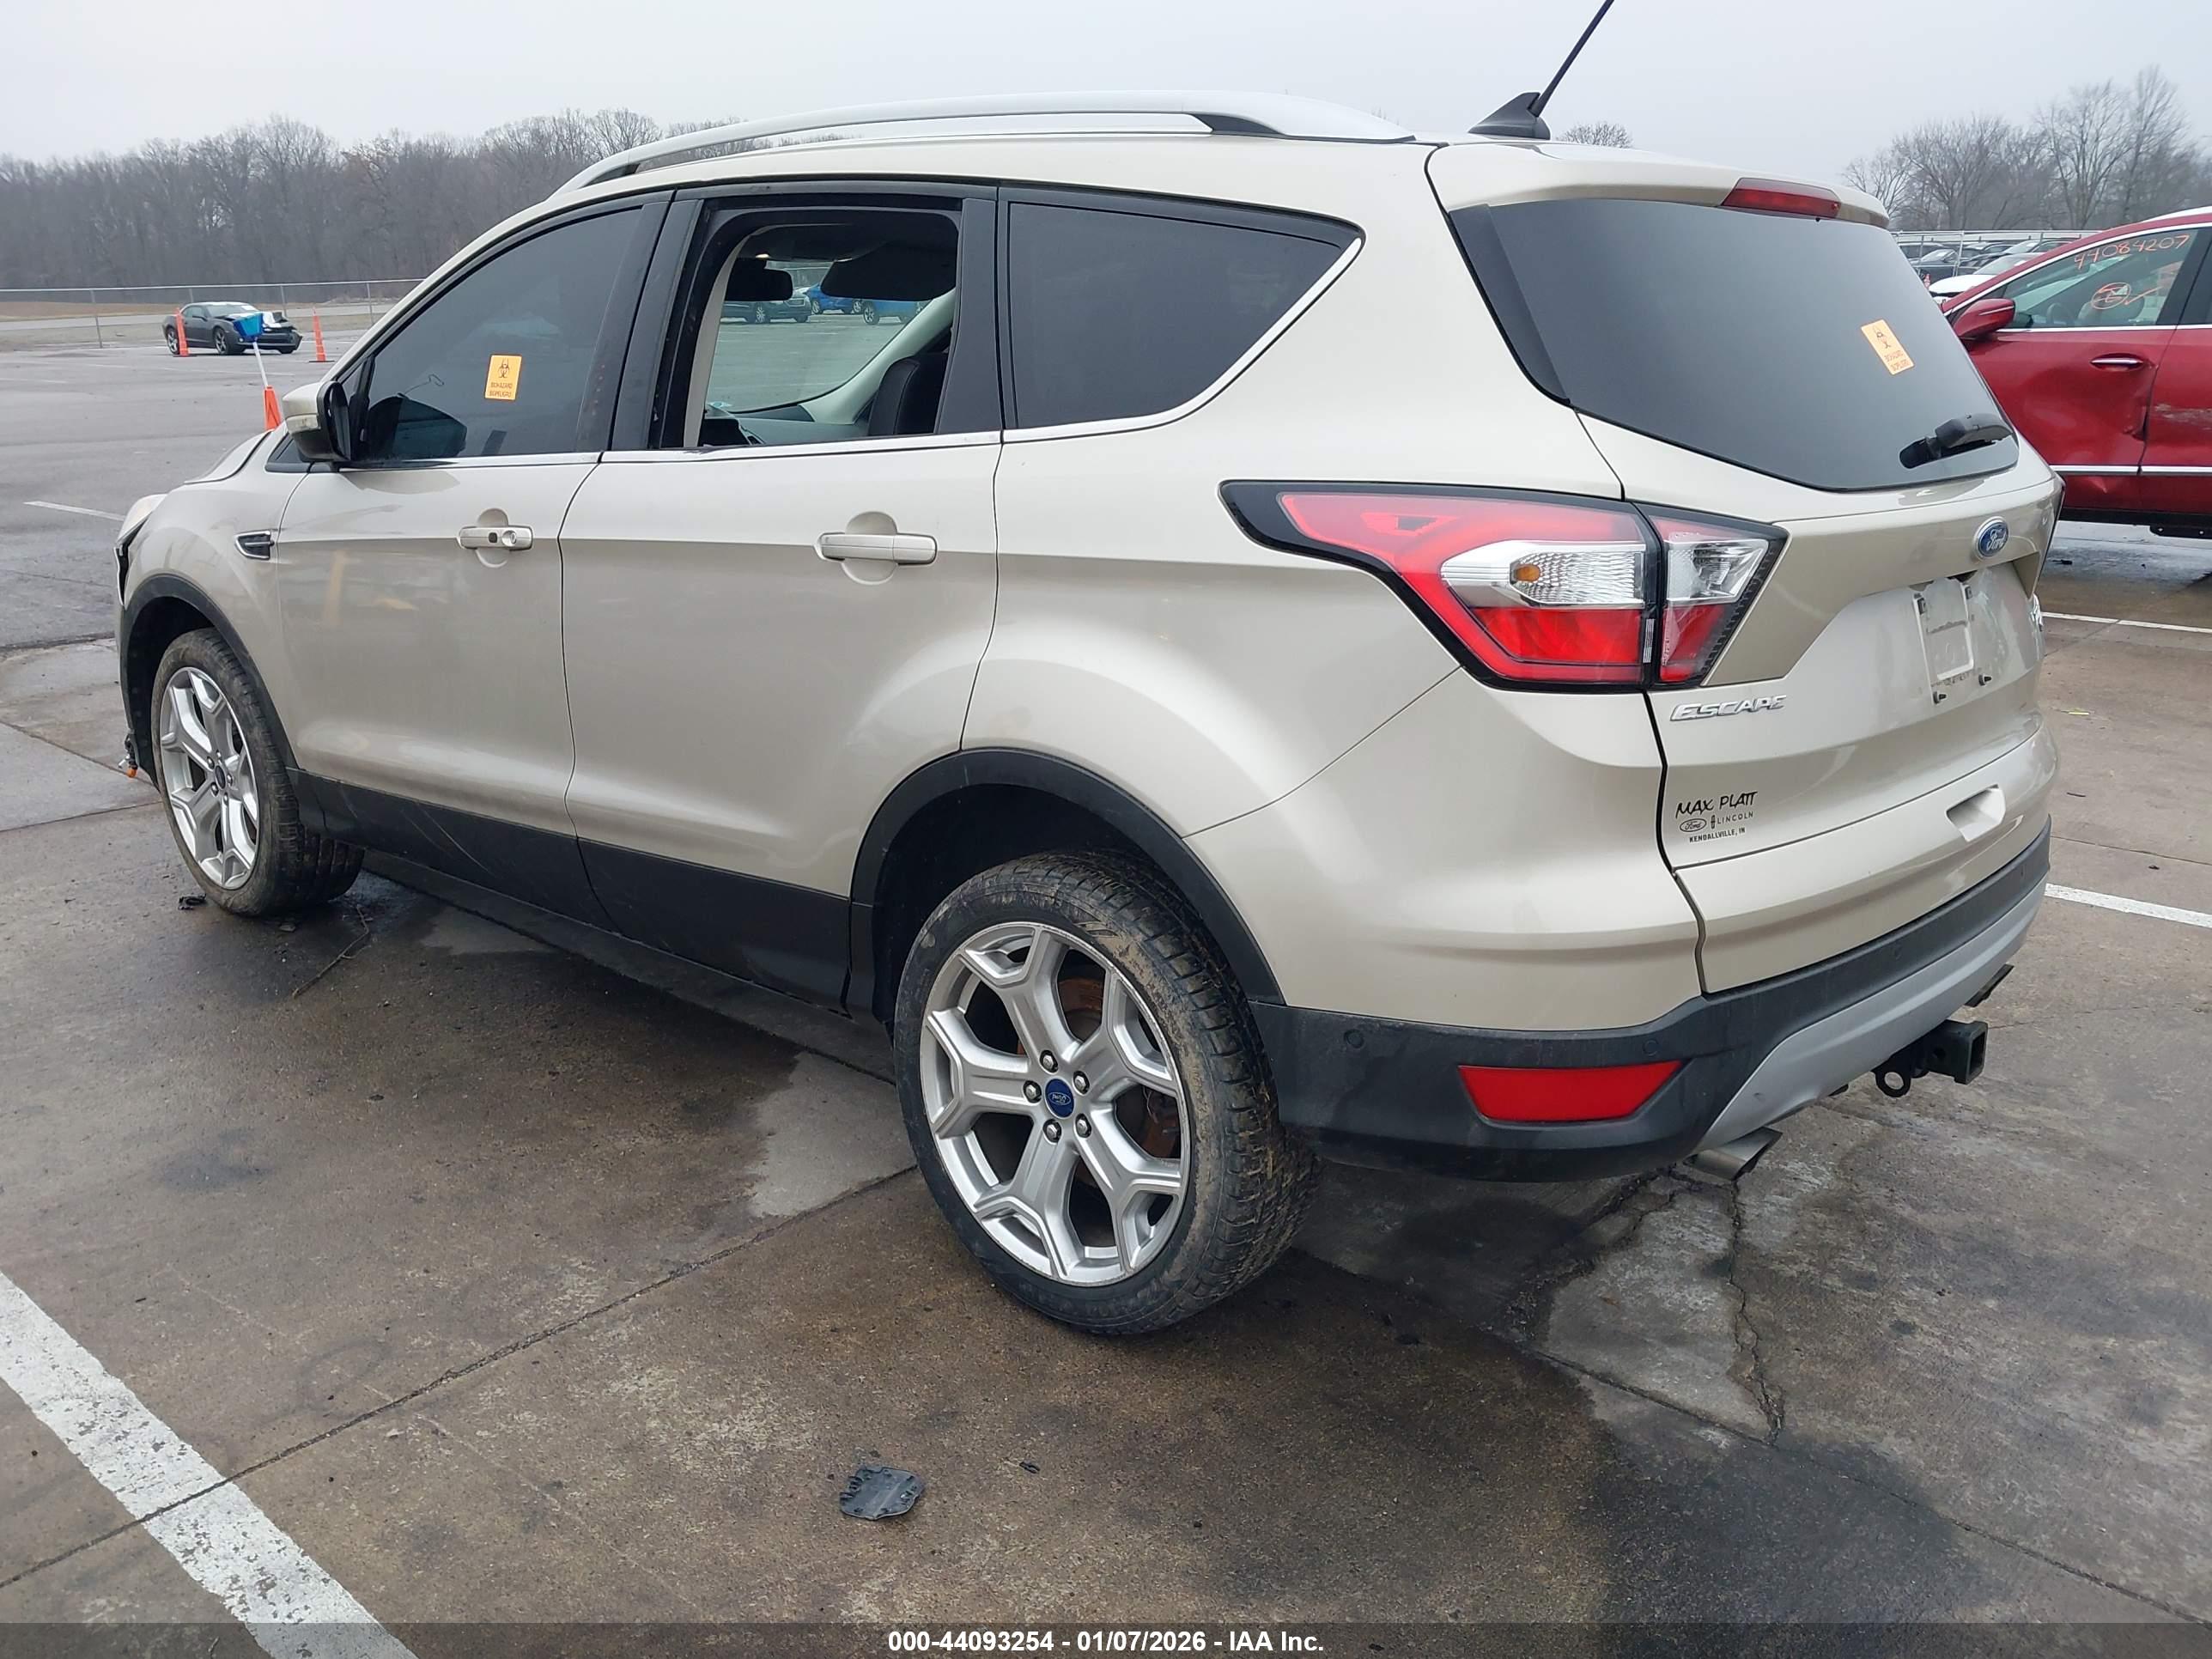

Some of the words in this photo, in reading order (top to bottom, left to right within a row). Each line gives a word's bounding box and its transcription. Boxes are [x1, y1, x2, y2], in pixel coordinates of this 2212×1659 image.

[2074, 234, 2190, 270] 44084207
[1670, 695, 1787, 721] ESCAPE
[1675, 799, 1714, 819] MAX
[1719, 791, 1758, 810] PLATT
[1717, 811, 1753, 824] LINCOLN
[1689, 829, 1738, 843] KENDALLVILLE,
